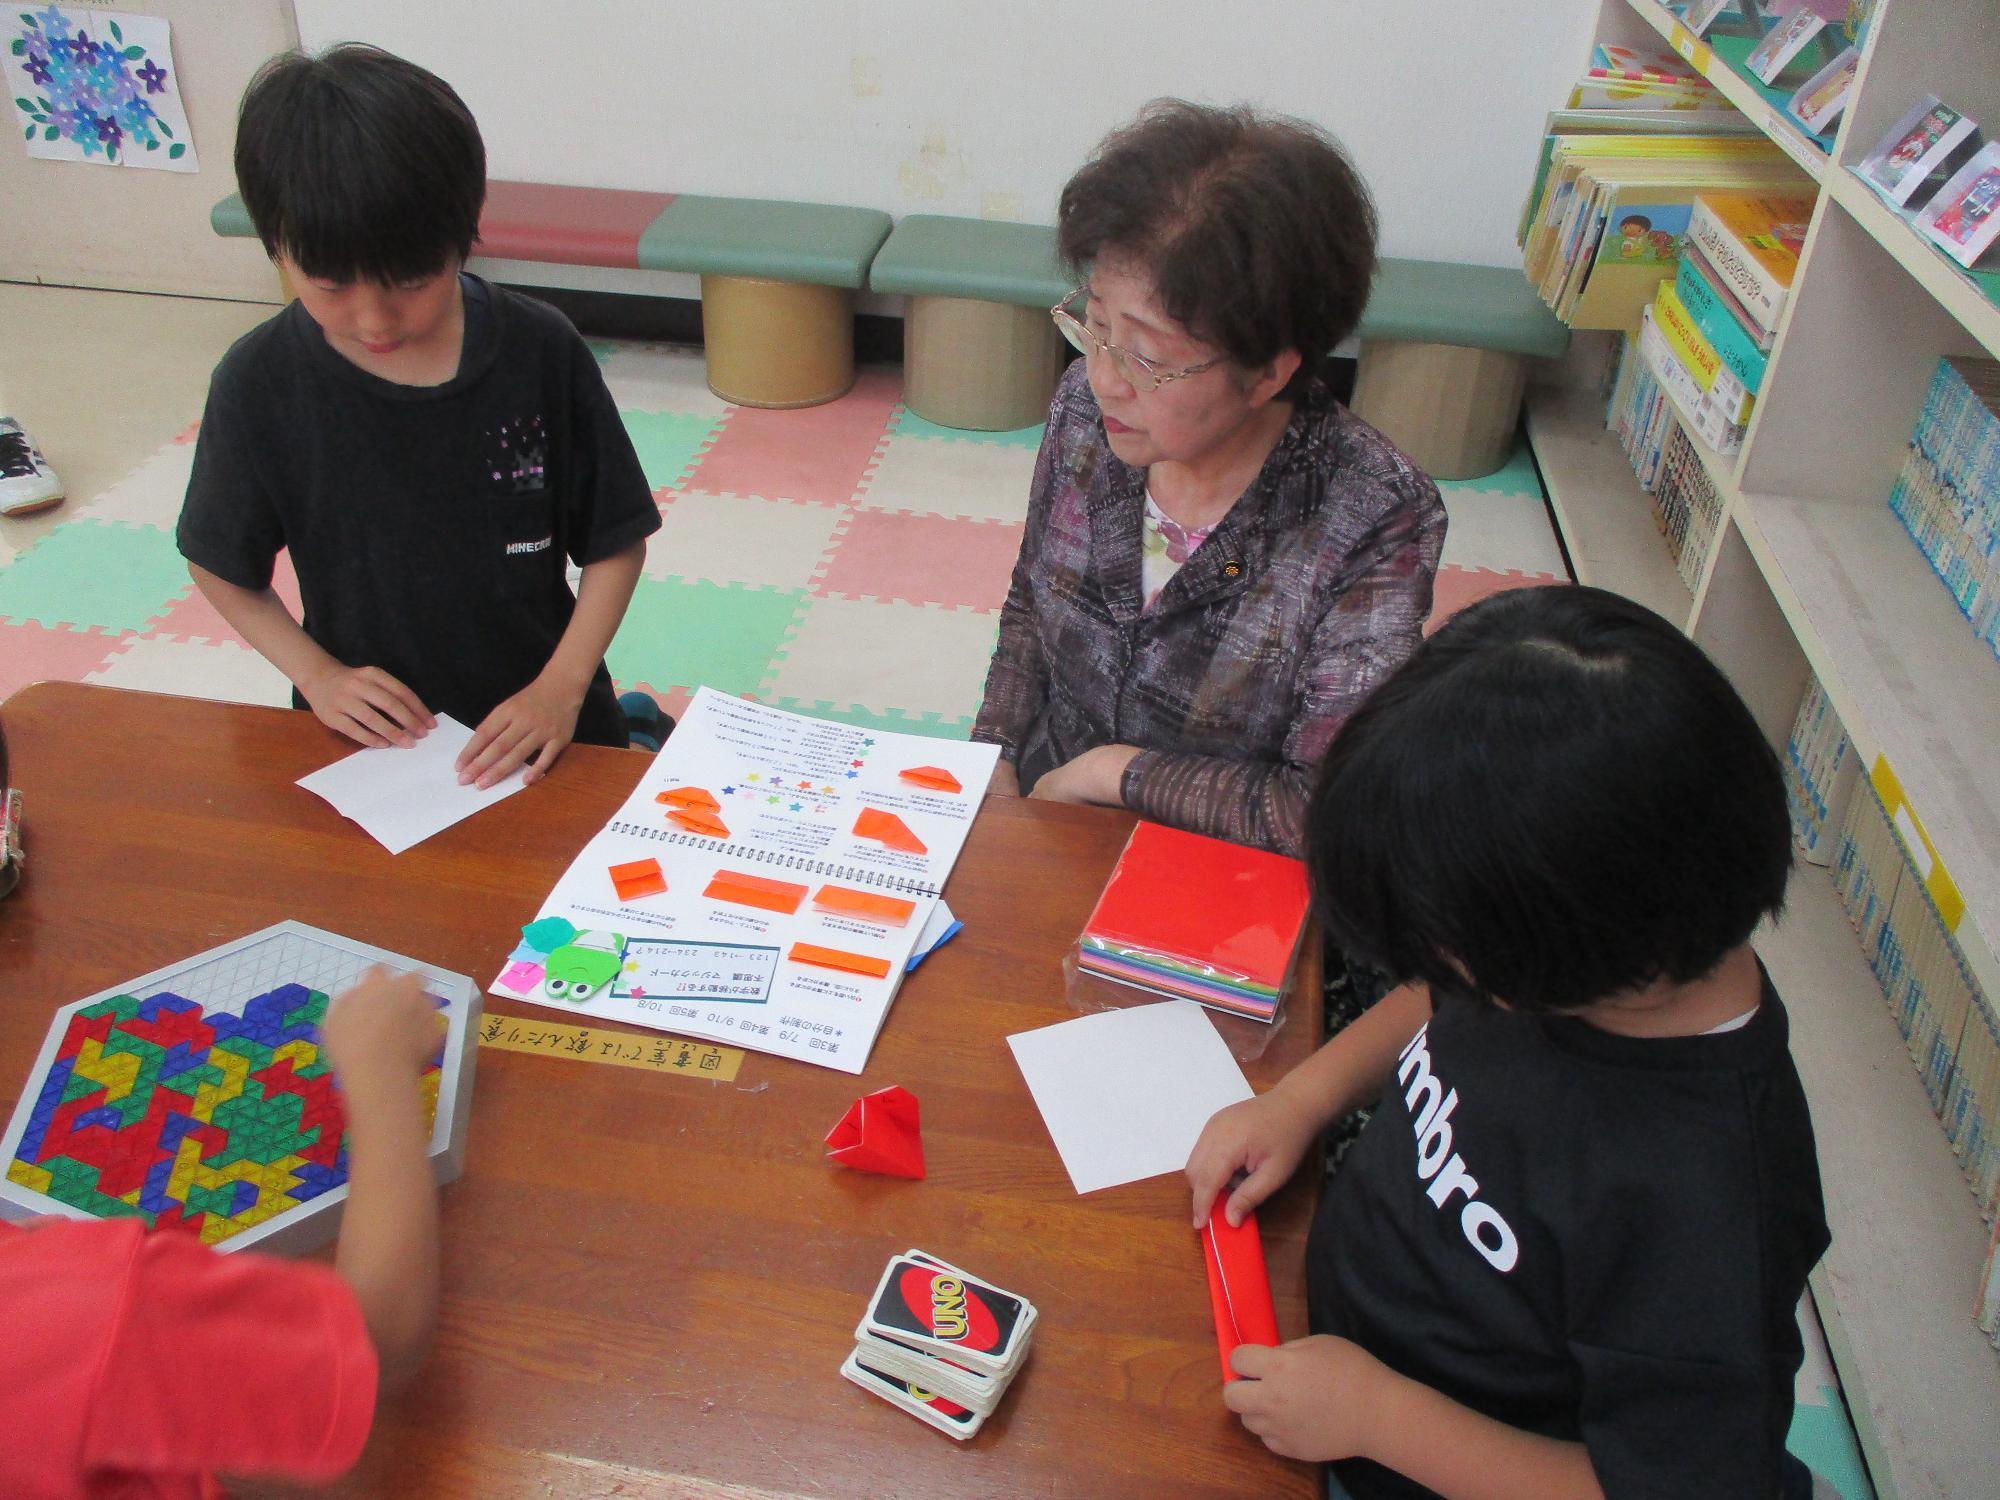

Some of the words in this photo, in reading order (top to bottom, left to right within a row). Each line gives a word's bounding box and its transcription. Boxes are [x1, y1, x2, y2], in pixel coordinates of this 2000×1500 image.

[649, 967, 720, 978] マジックカード
[731, 971, 764, 981] 不思議
[636, 999, 662, 1011] 10/8
[667, 1004, 698, 1018] 第5回
[706, 1012, 734, 1025] 9/10
[739, 1019, 769, 1035] 第4回
[778, 1029, 798, 1042] 7/9
[808, 1037, 839, 1053] 第3回
[930, 1274, 970, 1341] UNO
